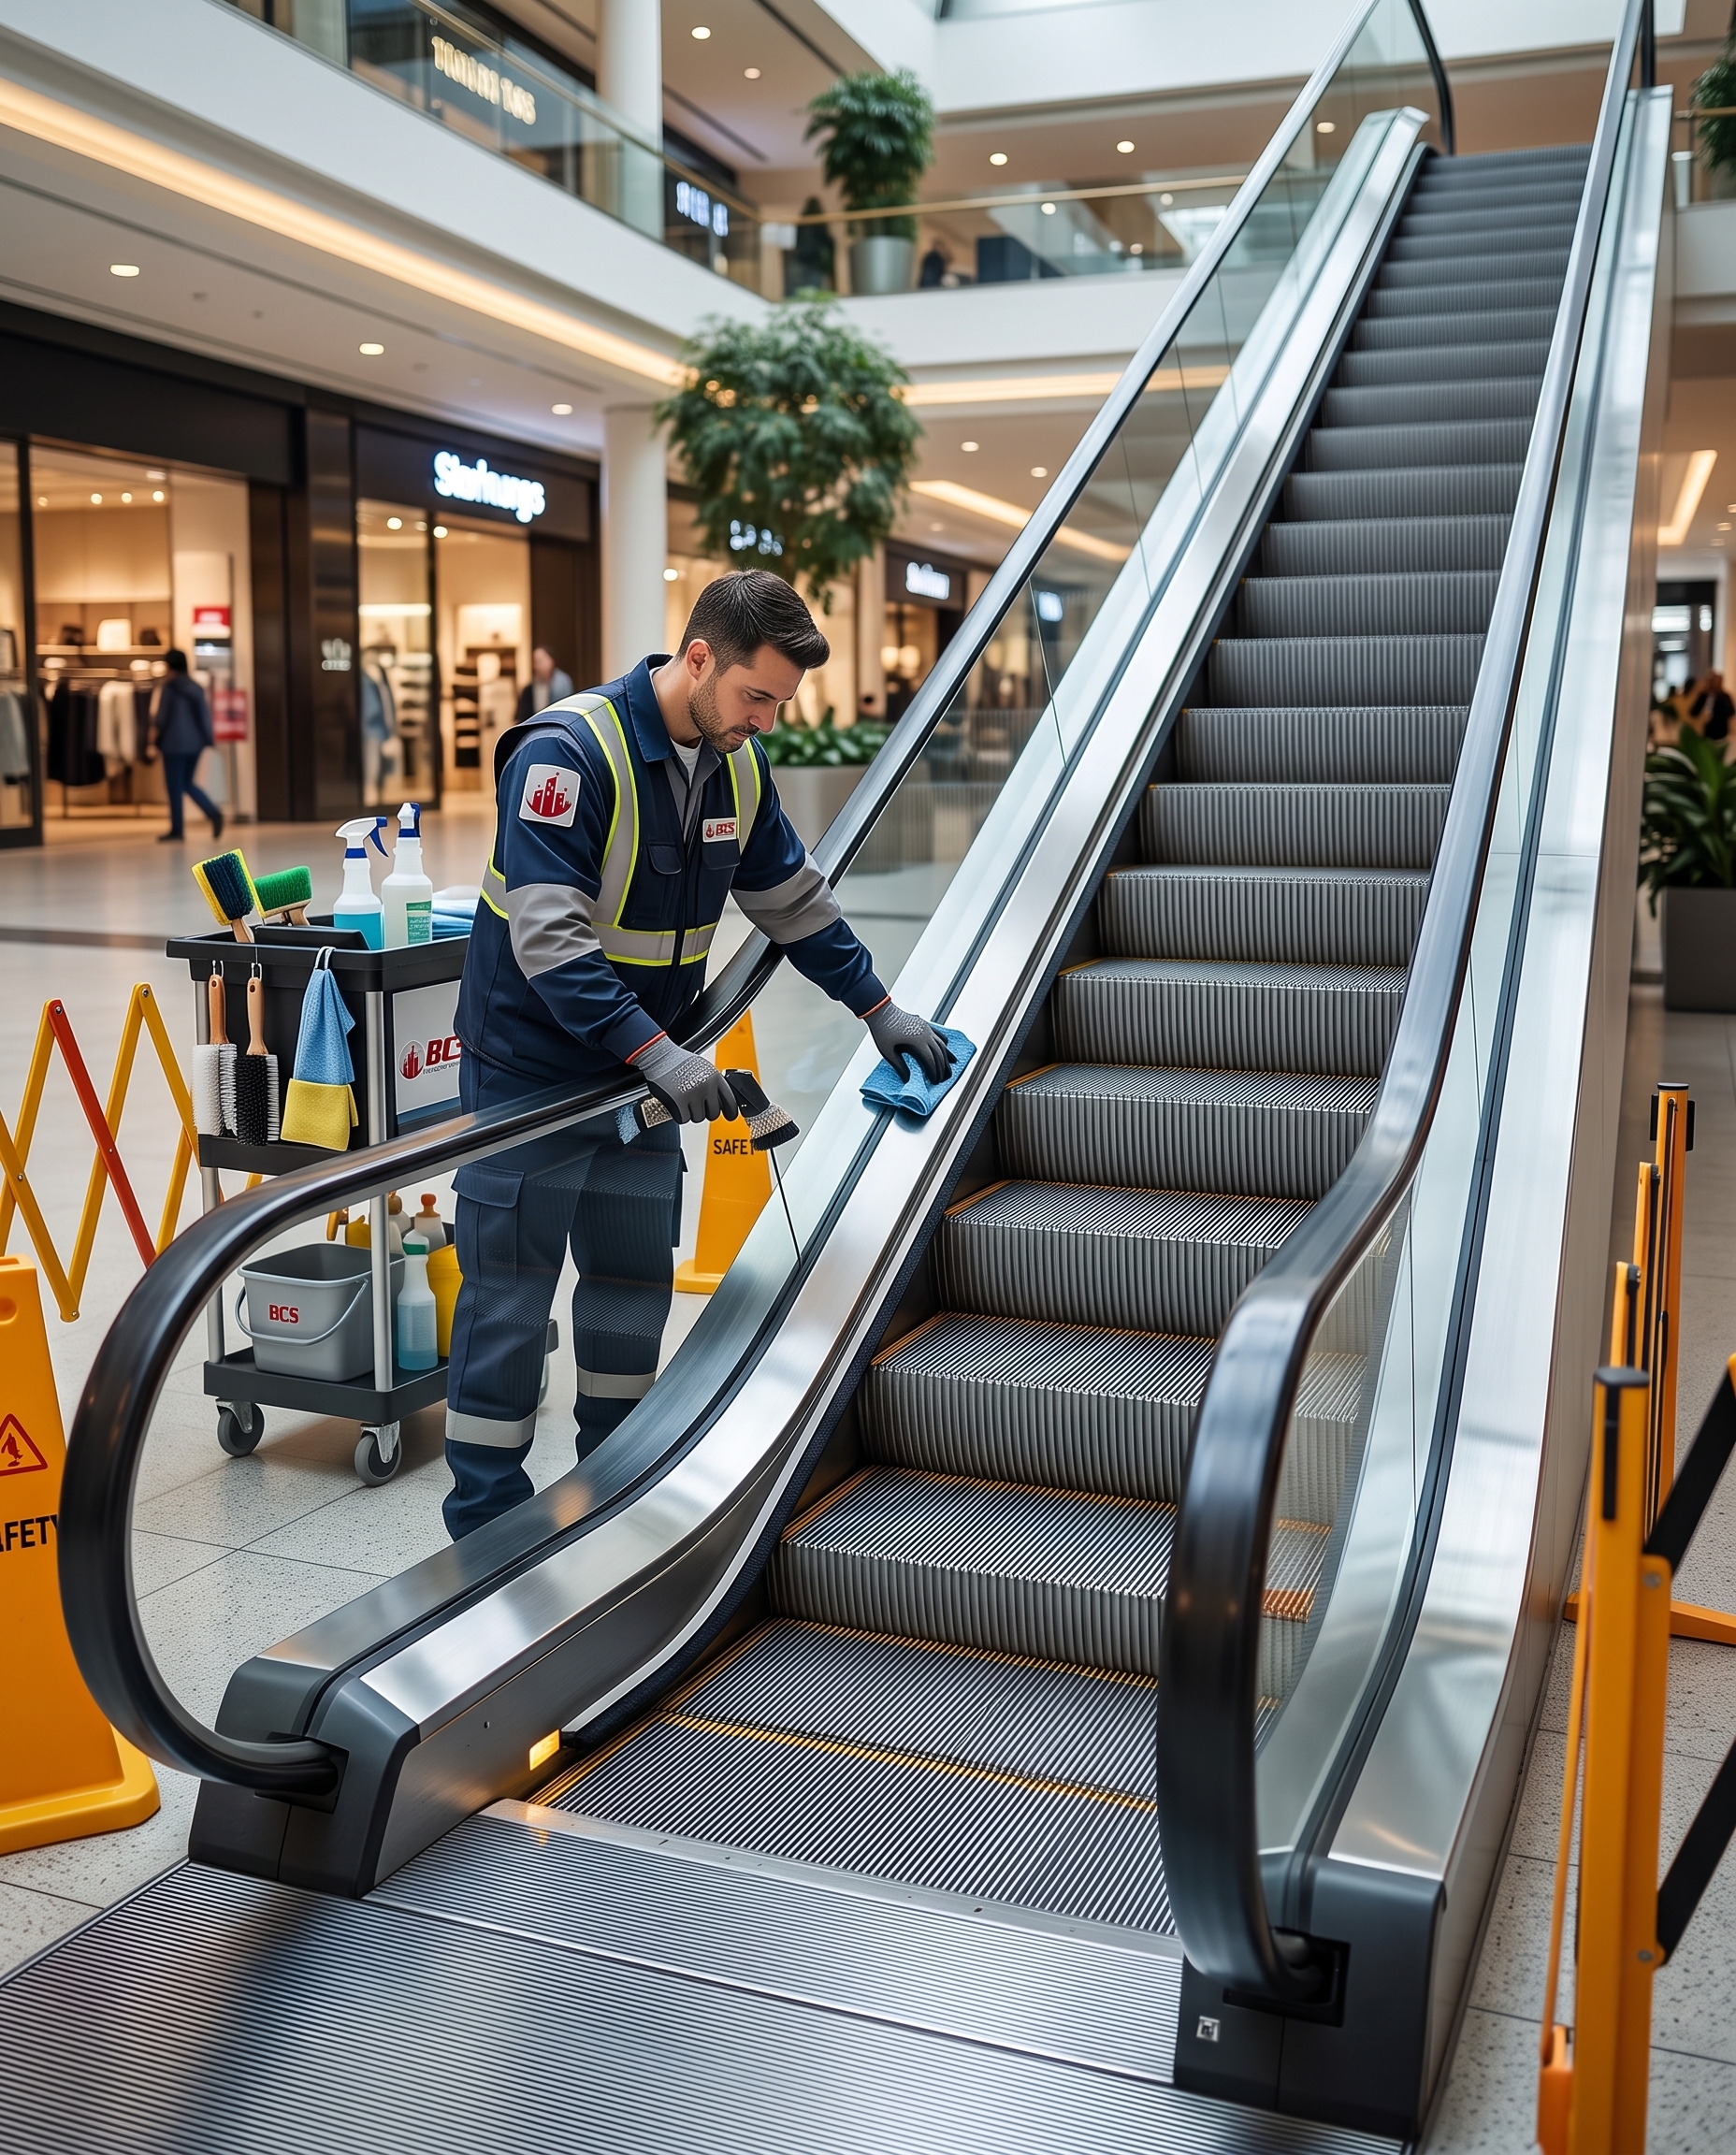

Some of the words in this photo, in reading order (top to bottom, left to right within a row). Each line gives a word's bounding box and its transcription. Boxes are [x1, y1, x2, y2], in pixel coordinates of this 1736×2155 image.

[426, 1035, 462, 1066] BC
[268, 1304, 299, 1324] BCS
[0, 1513, 58, 1553] FET
